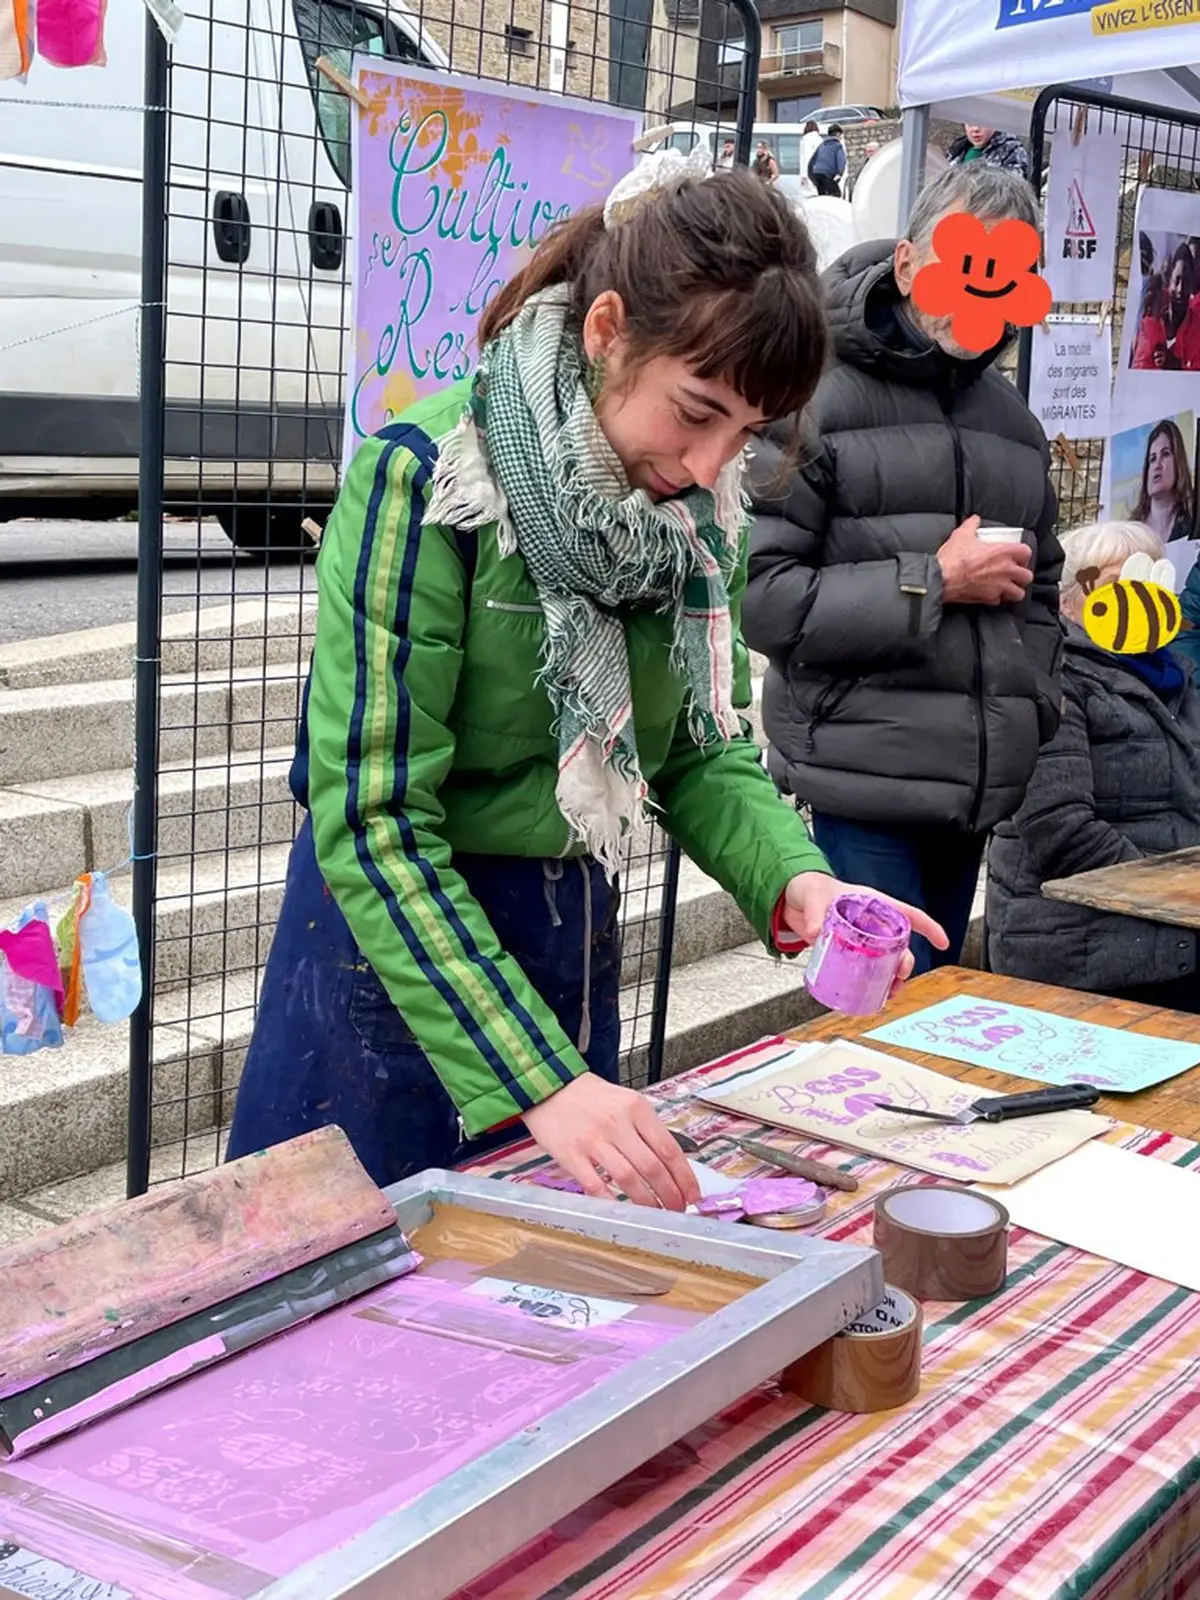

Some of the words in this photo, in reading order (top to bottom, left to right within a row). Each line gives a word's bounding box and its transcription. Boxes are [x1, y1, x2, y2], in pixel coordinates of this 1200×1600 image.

[1096, 9, 1137, 31] VIVEZ
[1141, 0, 1200, 22] L'ESSEN
[1054, 342, 1066, 356] La
[1047, 364, 1063, 378] des
[1071, 385, 1087, 398] des
[1042, 404, 1096, 420] MIGRANTES
